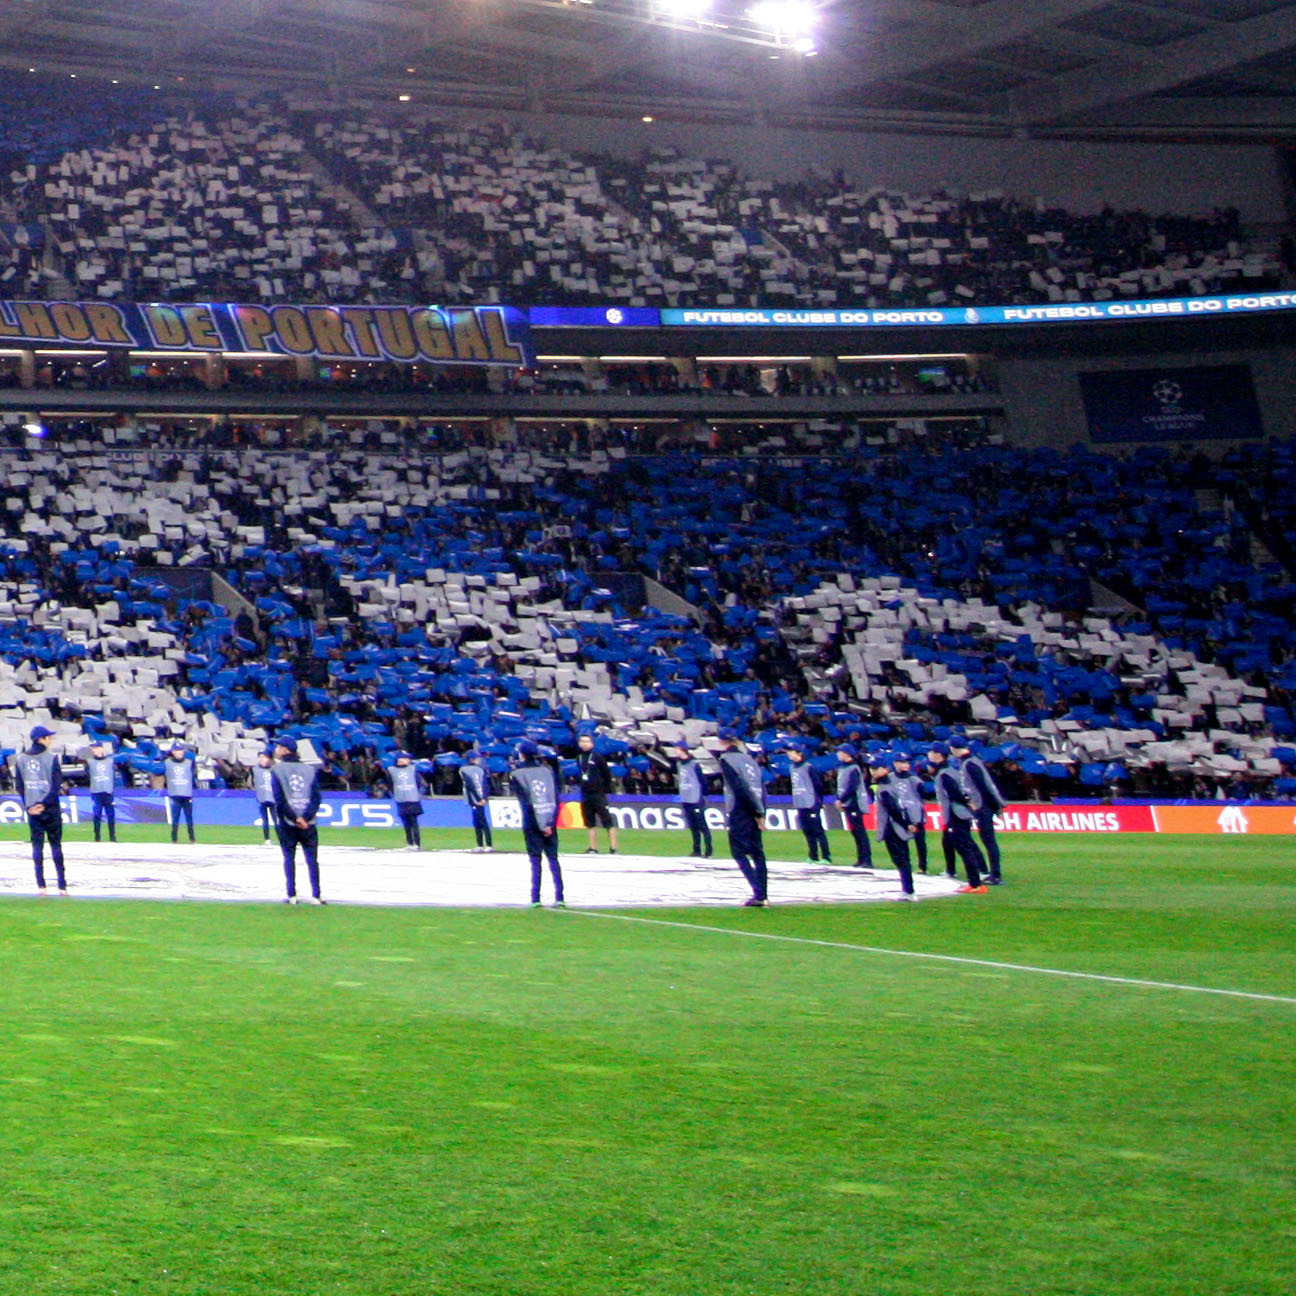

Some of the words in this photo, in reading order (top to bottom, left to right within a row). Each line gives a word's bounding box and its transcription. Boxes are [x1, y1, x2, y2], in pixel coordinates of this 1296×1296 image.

[683, 311, 770, 323] FUTEBOL
[773, 312, 836, 323] CLUBE
[840, 312, 869, 323] DO
[872, 311, 944, 323] PORTO
[1004, 305, 1105, 320] FUTEBOL
[1107, 302, 1183, 317] CLUBE
[1187, 299, 1223, 313] DO
[145, 305, 223, 347] DE
[233, 306, 522, 362] PORTUGAL
[607, 806, 828, 830] masear
[1026, 812, 1120, 832] AIRLINES
